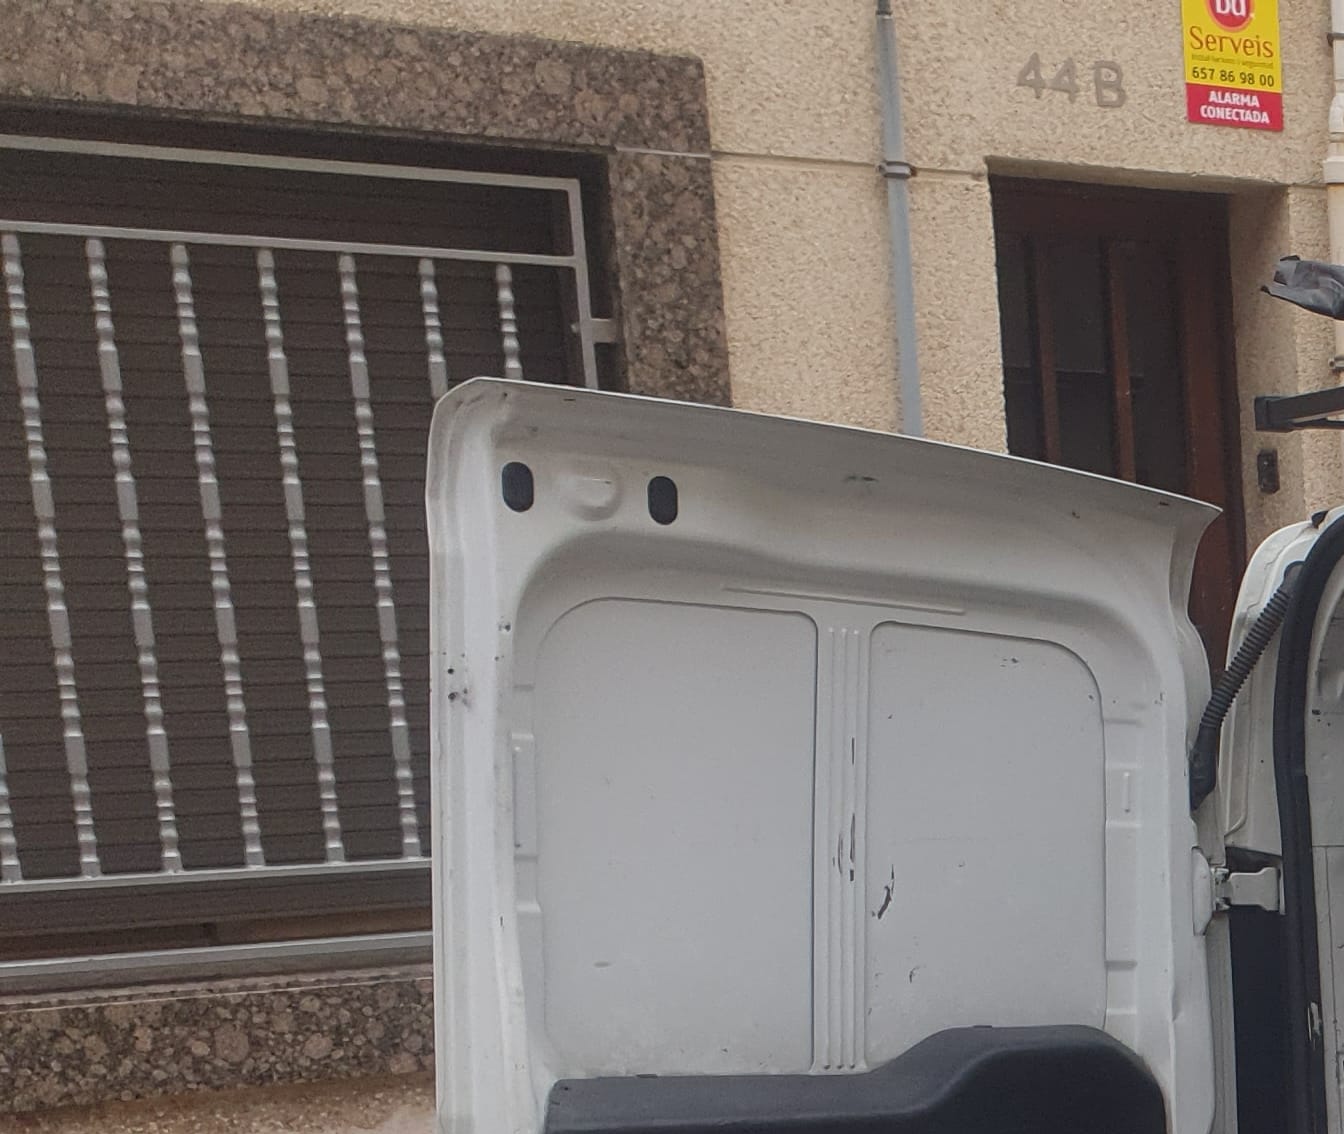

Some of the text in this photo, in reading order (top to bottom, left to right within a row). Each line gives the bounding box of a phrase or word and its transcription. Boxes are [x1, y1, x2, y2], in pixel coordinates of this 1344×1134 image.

[1189, 25, 1275, 58] Serveis
[1192, 66, 1275, 87] 657 86 98 00
[1208, 90, 1260, 108] ALARMA
[1200, 105, 1271, 124] CONECTADA
